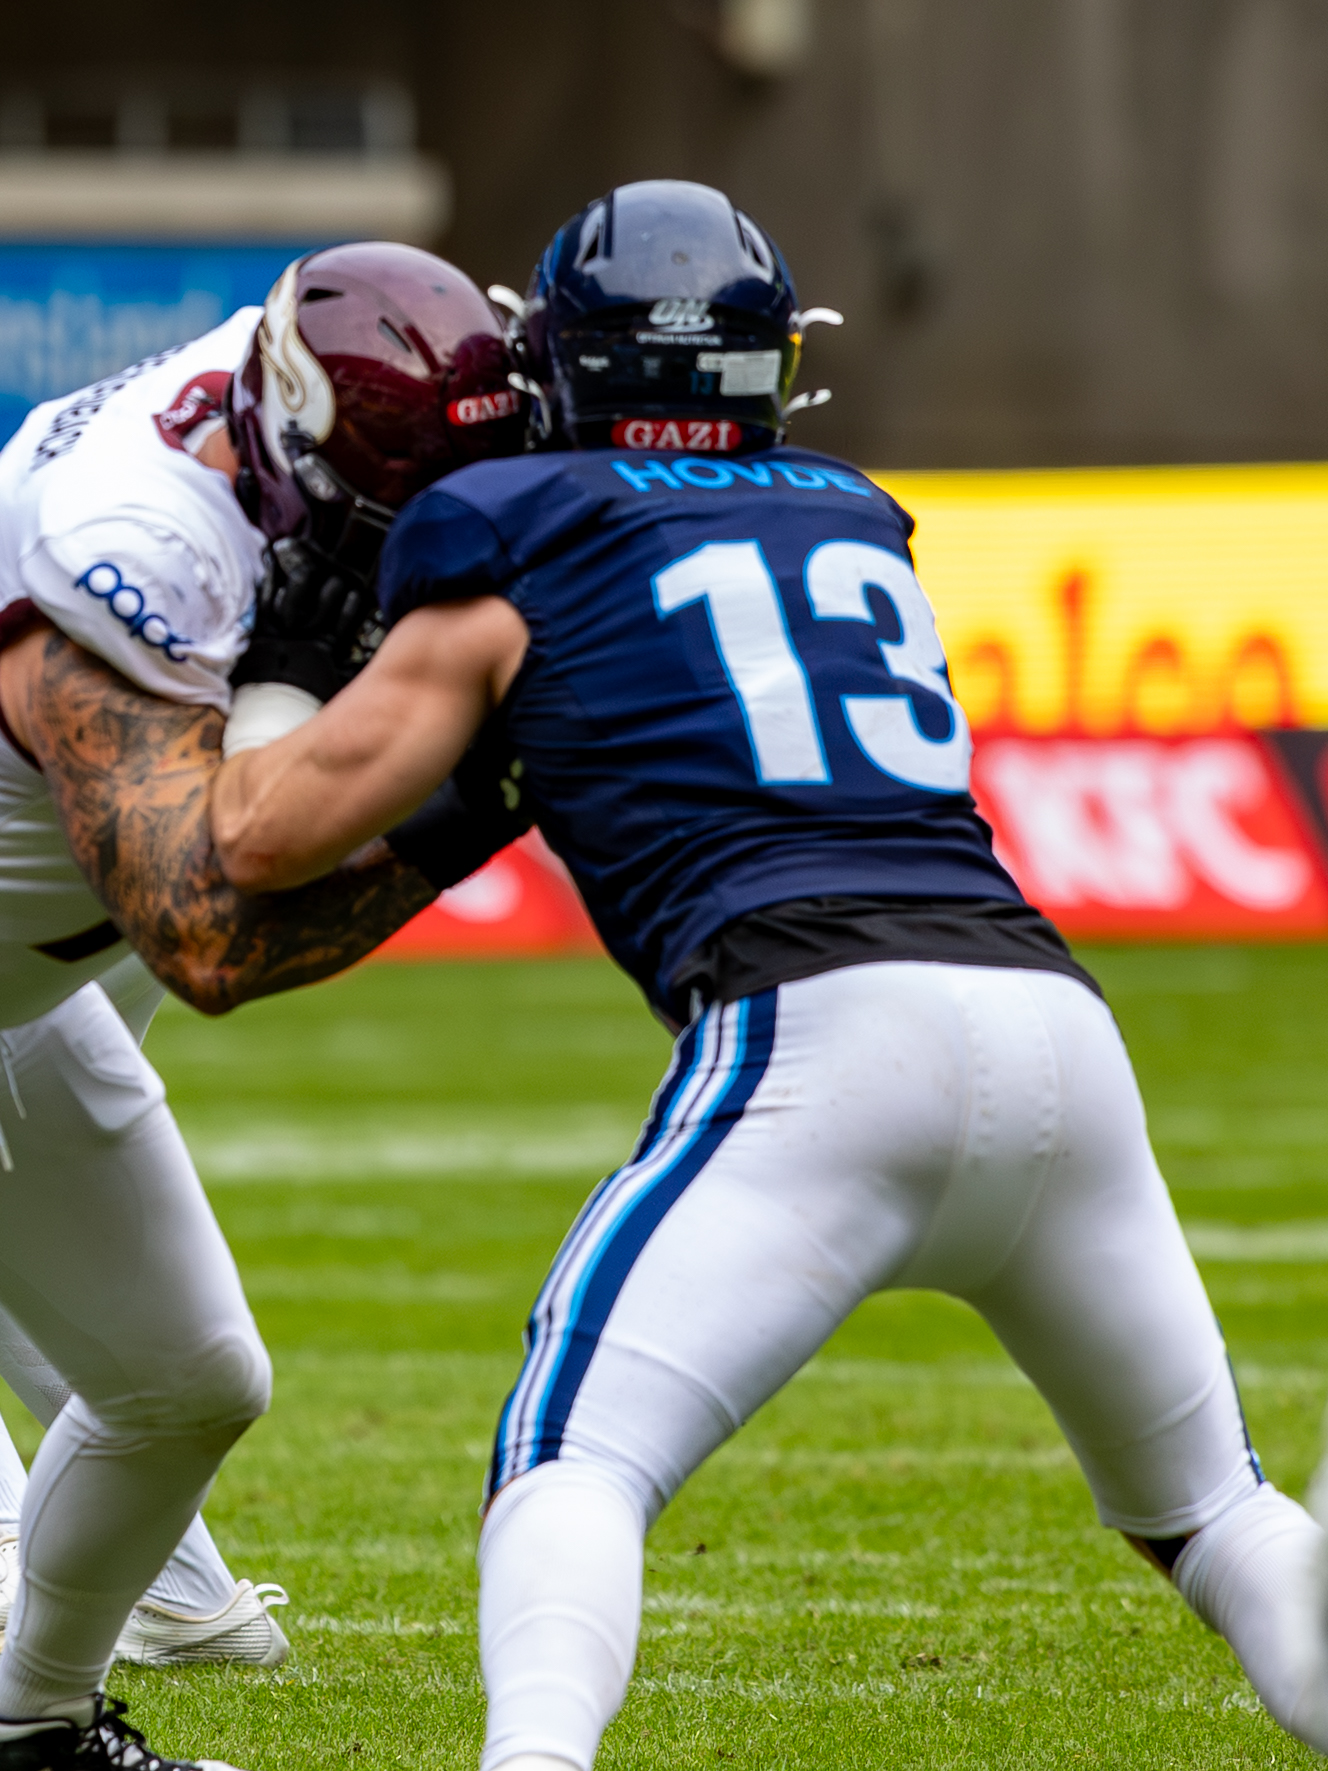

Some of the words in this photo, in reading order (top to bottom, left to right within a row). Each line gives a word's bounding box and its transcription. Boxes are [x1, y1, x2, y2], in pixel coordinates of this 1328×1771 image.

[624, 420, 731, 450] GAZI
[610, 457, 872, 497] HOVDE
[650, 538, 974, 794] 13
